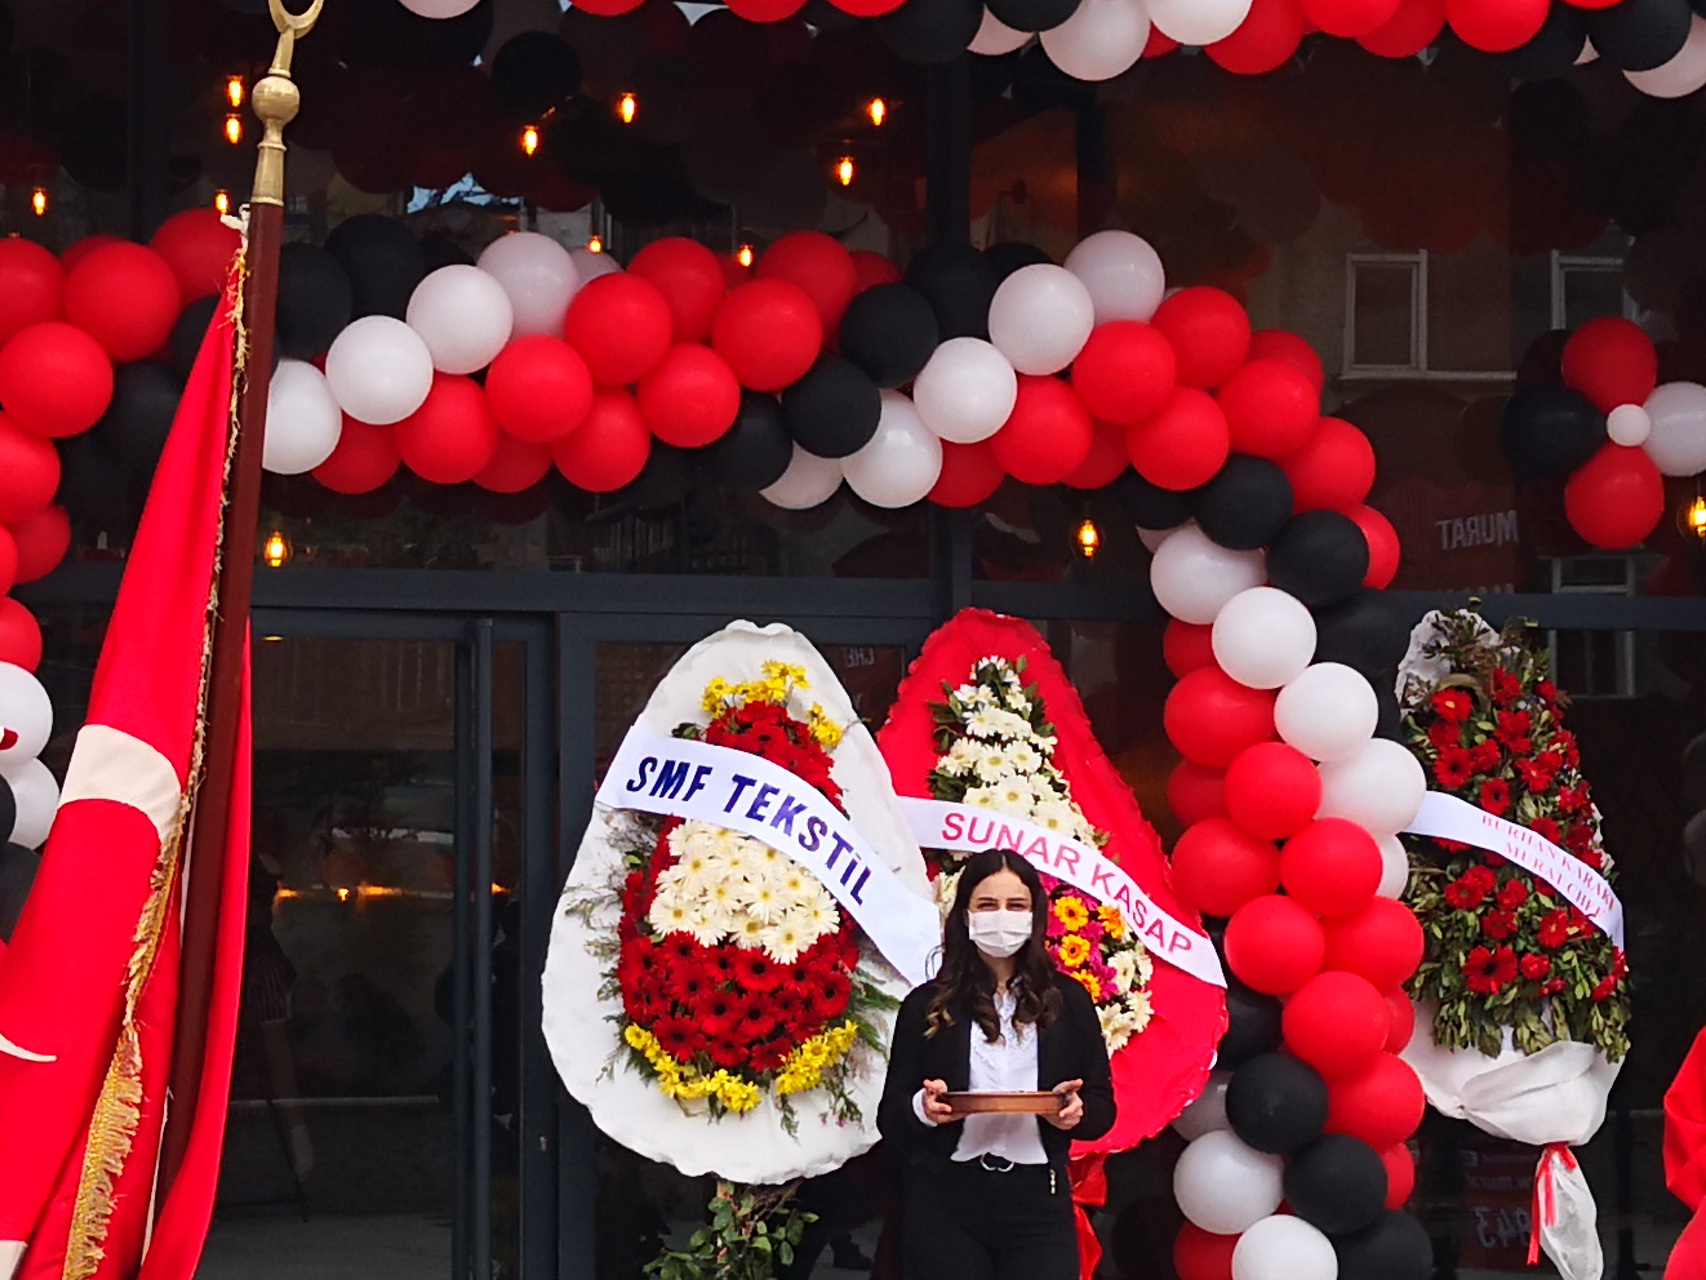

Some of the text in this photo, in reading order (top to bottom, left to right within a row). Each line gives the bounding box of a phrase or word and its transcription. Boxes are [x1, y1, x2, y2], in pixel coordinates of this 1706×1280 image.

[626, 756, 713, 802] SMF
[1481, 814, 1558, 859] BURHAN
[942, 812, 1192, 954] SUNAR KASAP
[1505, 842, 1564, 886] MURAT
